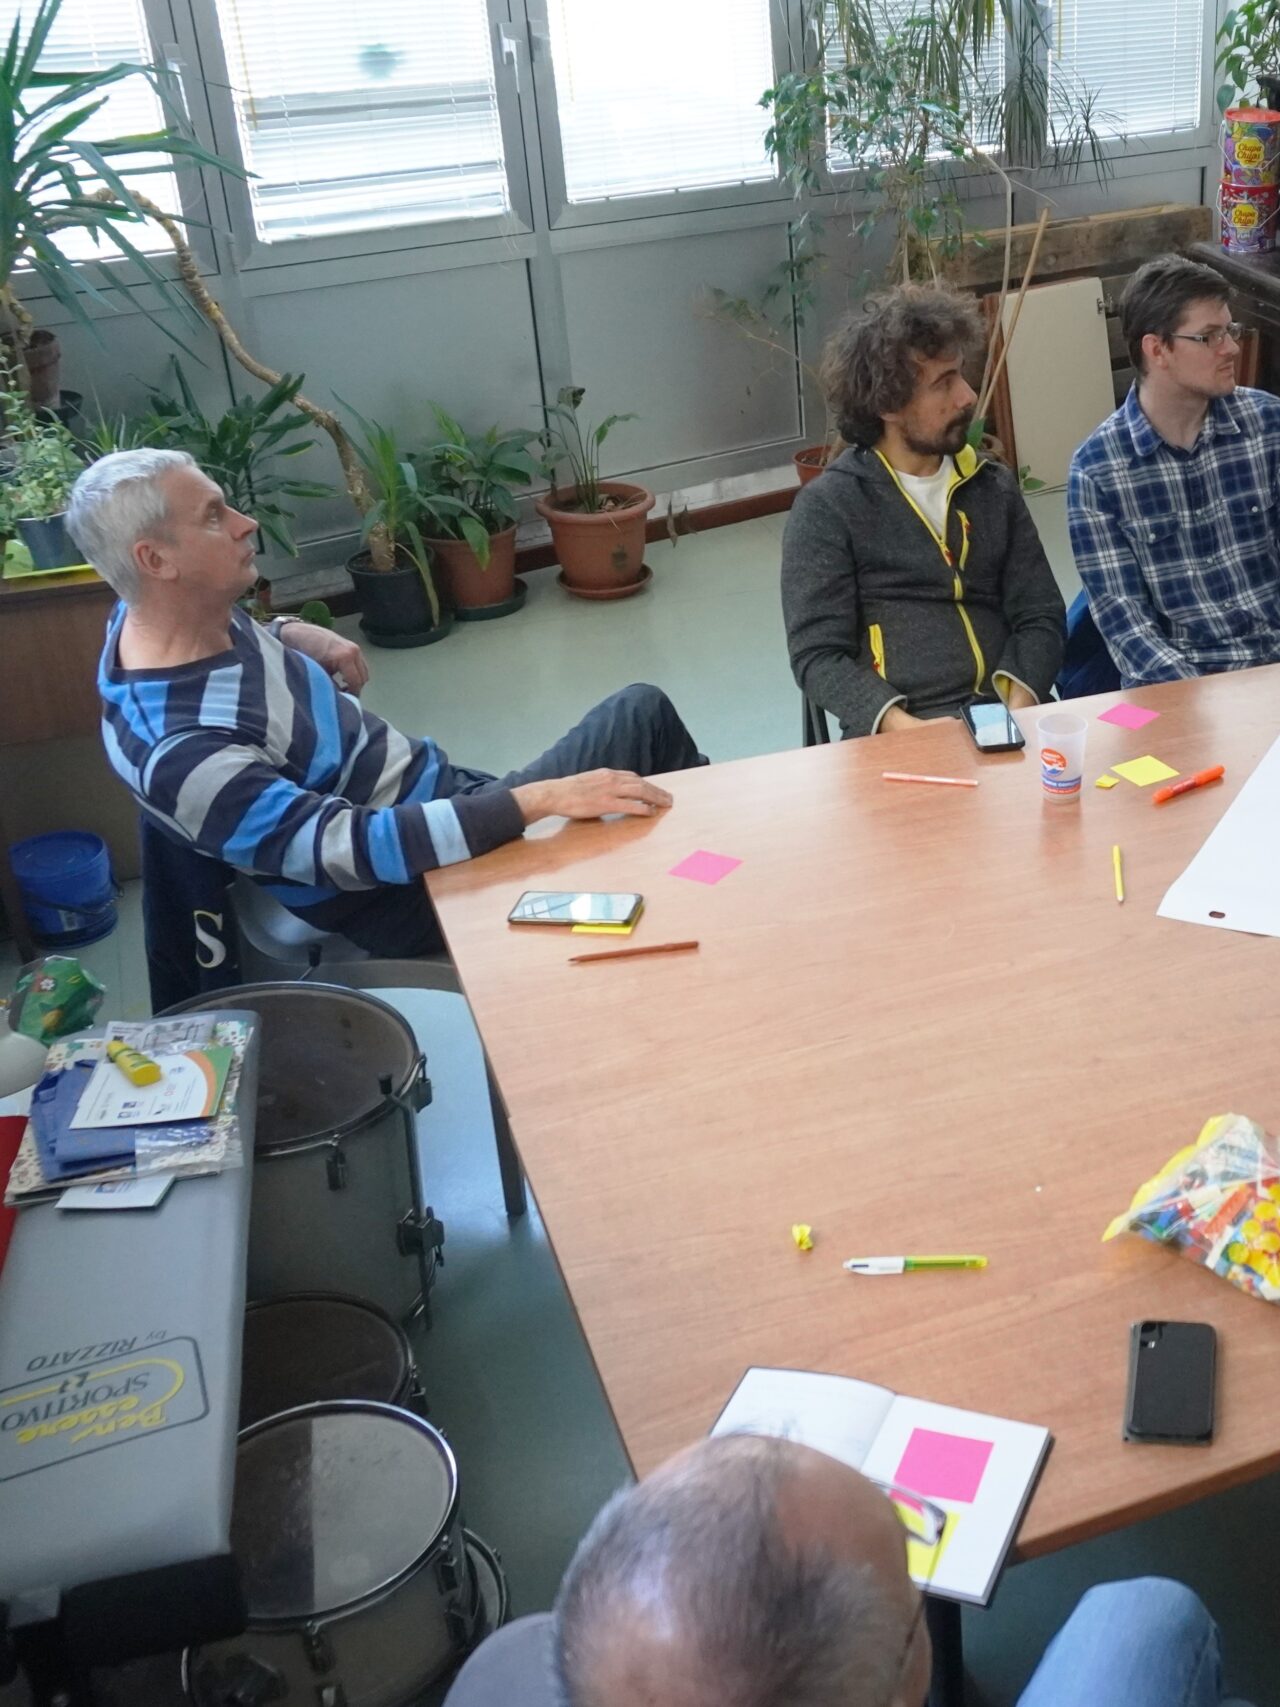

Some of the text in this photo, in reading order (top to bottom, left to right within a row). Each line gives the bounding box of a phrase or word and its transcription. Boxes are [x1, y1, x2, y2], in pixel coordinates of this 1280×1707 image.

[1238, 143, 1262, 152] Chupa
[1237, 151, 1261, 161] Chups
[1234, 209, 1256, 217] Chupa
[1233, 216, 1255, 225] Chups
[26, 1329, 167, 1372] by RIZZATO
[1, 1372, 150, 1432] SPORTIVO
